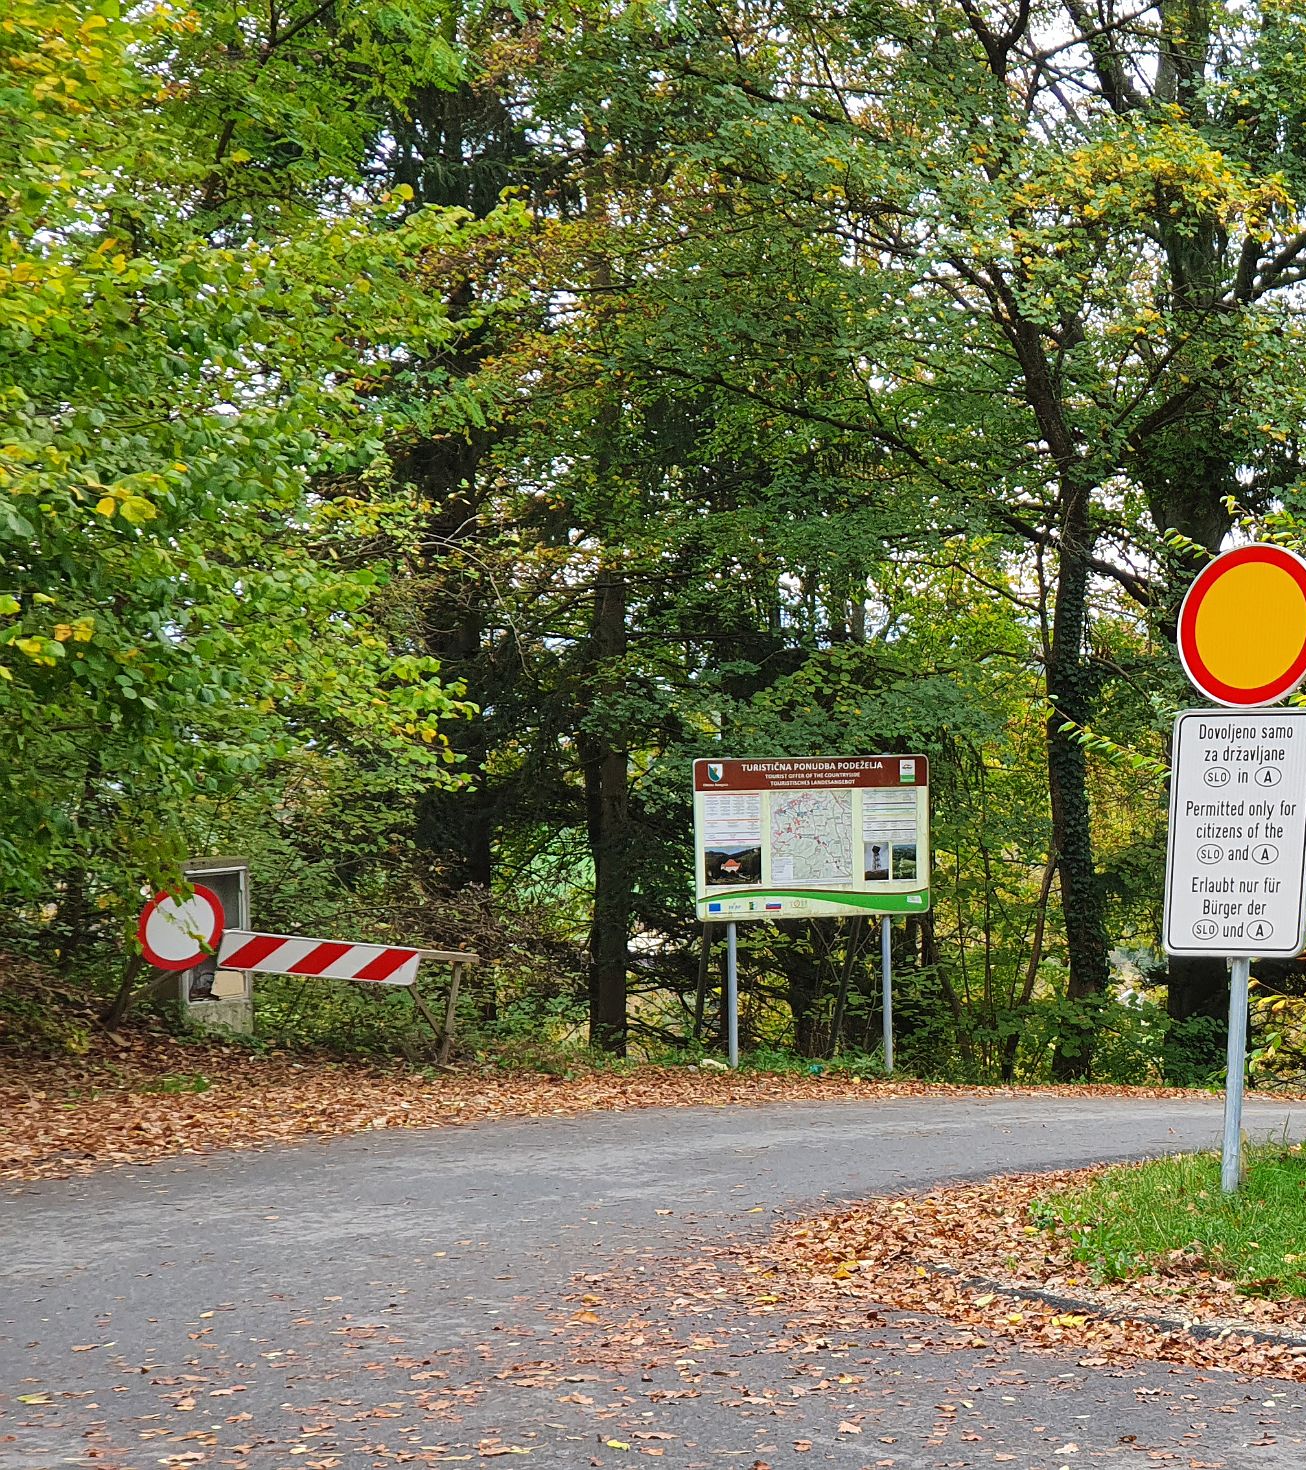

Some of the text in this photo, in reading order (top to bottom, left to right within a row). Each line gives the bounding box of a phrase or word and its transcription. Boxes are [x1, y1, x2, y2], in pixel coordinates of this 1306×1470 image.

[1198, 723, 1294, 744] Dovoljeno samo
[1204, 745, 1286, 766] za državljane
[741, 760, 883, 771] TURISTIČNA PONUDBA PODEŽELJA
[1207, 767, 1273, 784] SLO in A
[1185, 800, 1297, 820] Permitted only for
[1196, 822, 1284, 839] citizens of the
[1200, 845, 1270, 861] SLO and A
[1191, 876, 1282, 893] Erlaubt nur für
[1203, 898, 1267, 918] Bürger der
[1195, 921, 1264, 938] SLO und A
